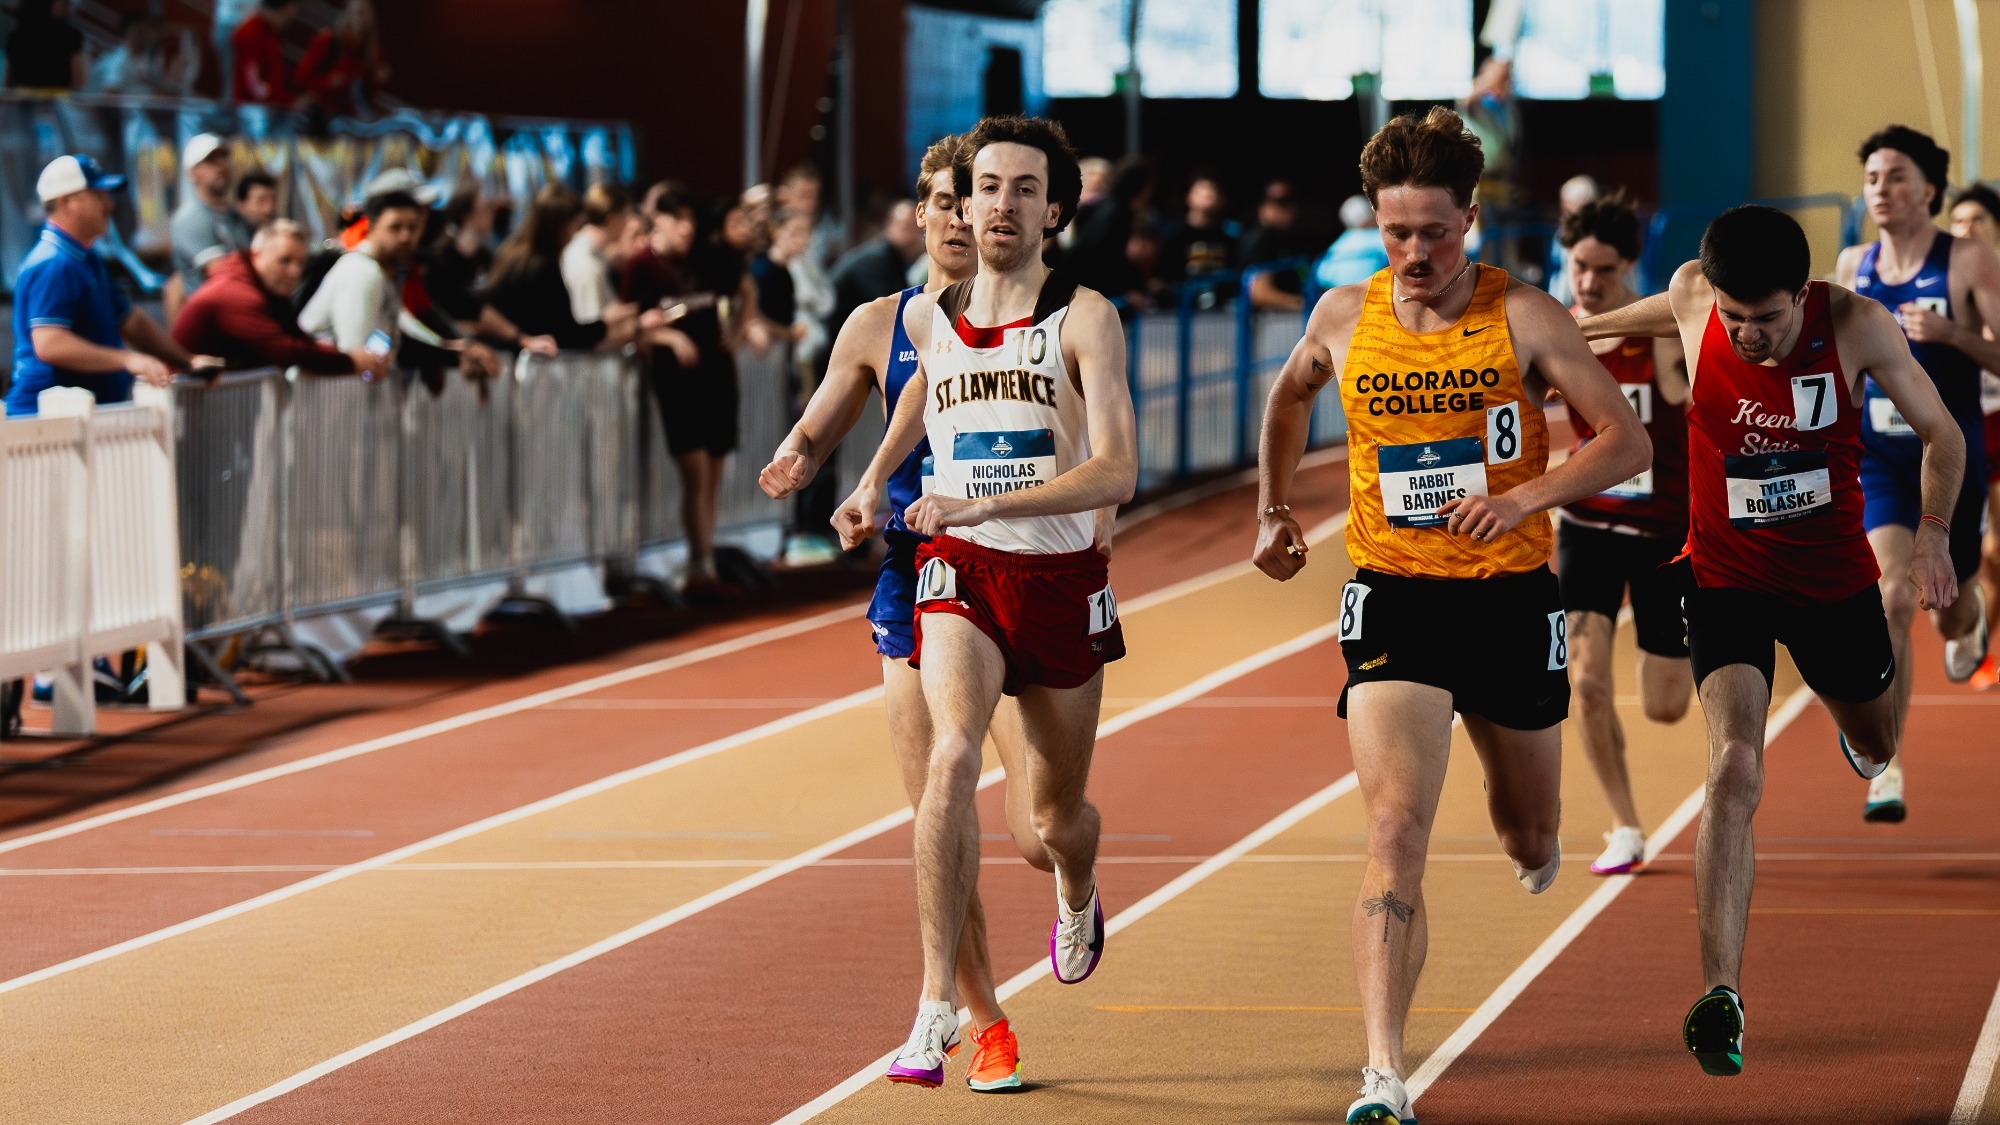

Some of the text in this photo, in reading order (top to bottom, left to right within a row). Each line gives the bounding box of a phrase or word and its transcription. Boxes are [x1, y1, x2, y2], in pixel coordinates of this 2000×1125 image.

[1012, 327, 1047, 366] 10
[935, 368, 1059, 414] ST. LAWRENCE
[1356, 367, 1501, 394] COLORADO
[1368, 391, 1485, 417] COLLEGE
[1800, 377, 1827, 428] 7
[1495, 406, 1517, 460] 8
[972, 462, 1036, 479] NICHOLAS
[1408, 472, 1455, 491] RABBIT
[1758, 478, 1797, 496] TYLER
[1745, 490, 1817, 514] BOLASKE
[919, 558, 947, 600] 10
[1096, 587, 1115, 628] 10
[1341, 586, 1360, 638] 8
[1555, 613, 1567, 667] 8
